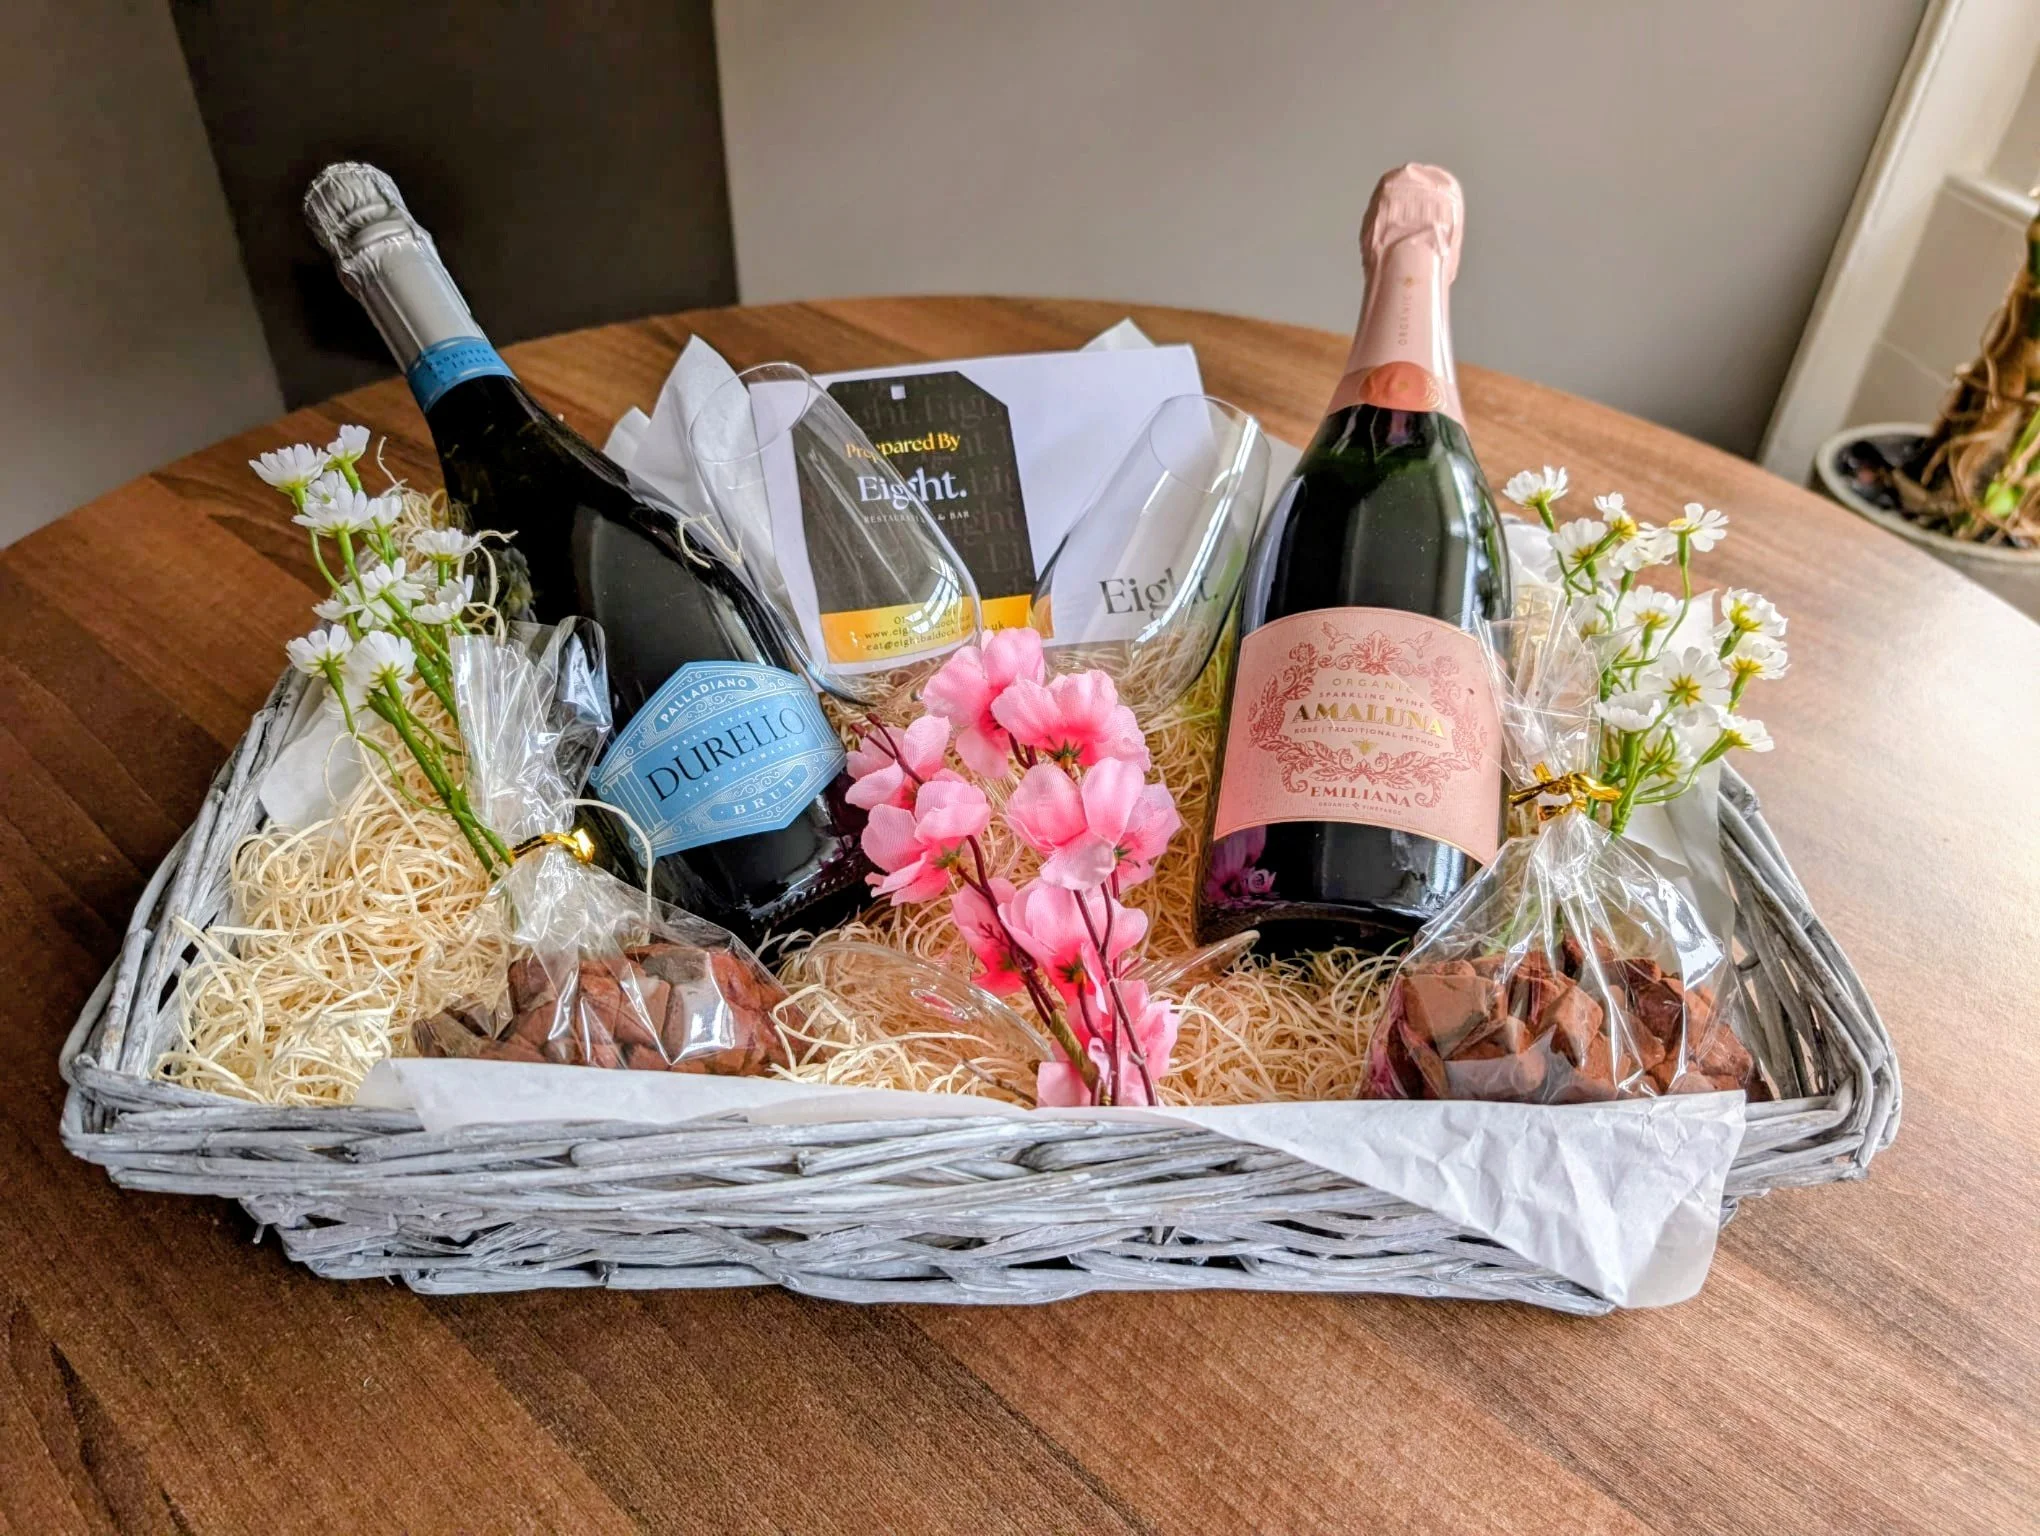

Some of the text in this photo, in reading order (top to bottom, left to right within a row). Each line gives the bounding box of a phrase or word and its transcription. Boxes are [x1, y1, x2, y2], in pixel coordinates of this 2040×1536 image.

[845, 431, 936, 464] Prepared
[937, 431, 961, 452] By
[857, 465, 968, 511] Eight.
[937, 512, 946, 521] &
[949, 510, 970, 520] BAR
[660, 678, 748, 723] PALLADIANO
[1319, 691, 1425, 709] SPARKLING WINE
[1332, 677, 1414, 694] ORGANIC
[1290, 702, 1447, 741] AMALUNA
[1294, 726, 1441, 749] ROSÉ TRADITIONAL METHOD
[645, 707, 806, 802] DURELLO
[733, 778, 796, 816] BRUT
[1311, 786, 1412, 808] EMILIANA
